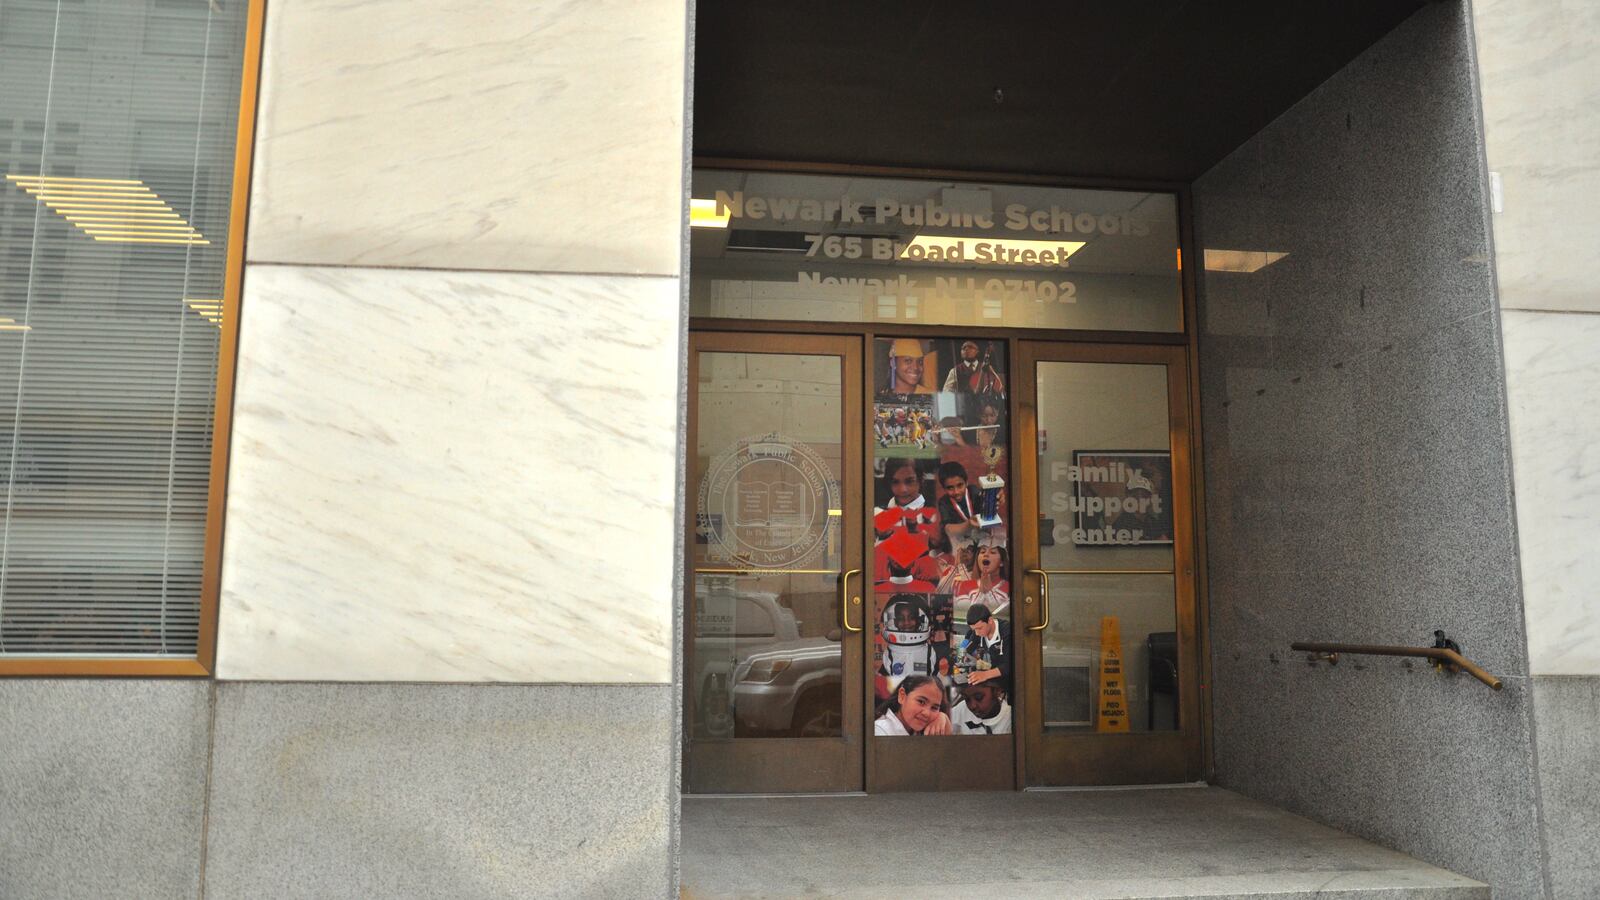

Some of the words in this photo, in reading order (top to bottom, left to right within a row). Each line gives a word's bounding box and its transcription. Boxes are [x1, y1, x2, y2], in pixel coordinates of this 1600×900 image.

[715, 190, 864, 223] Newark
[876, 199, 994, 229] Public
[1004, 203, 1150, 236] Schools
[804, 235, 862, 259] 765
[872, 238, 964, 263] Broad
[974, 242, 1069, 268] Street
[936, 277, 975, 301] NJ
[985, 279, 1077, 304] 07102
[764, 446, 796, 462] Public
[800, 460, 824, 497] Schools
[1051, 462, 1142, 490] Family
[1051, 492, 1162, 516] Support
[764, 552, 786, 563] New
[792, 530, 818, 556] Jersey
[1052, 524, 1143, 545] Center
